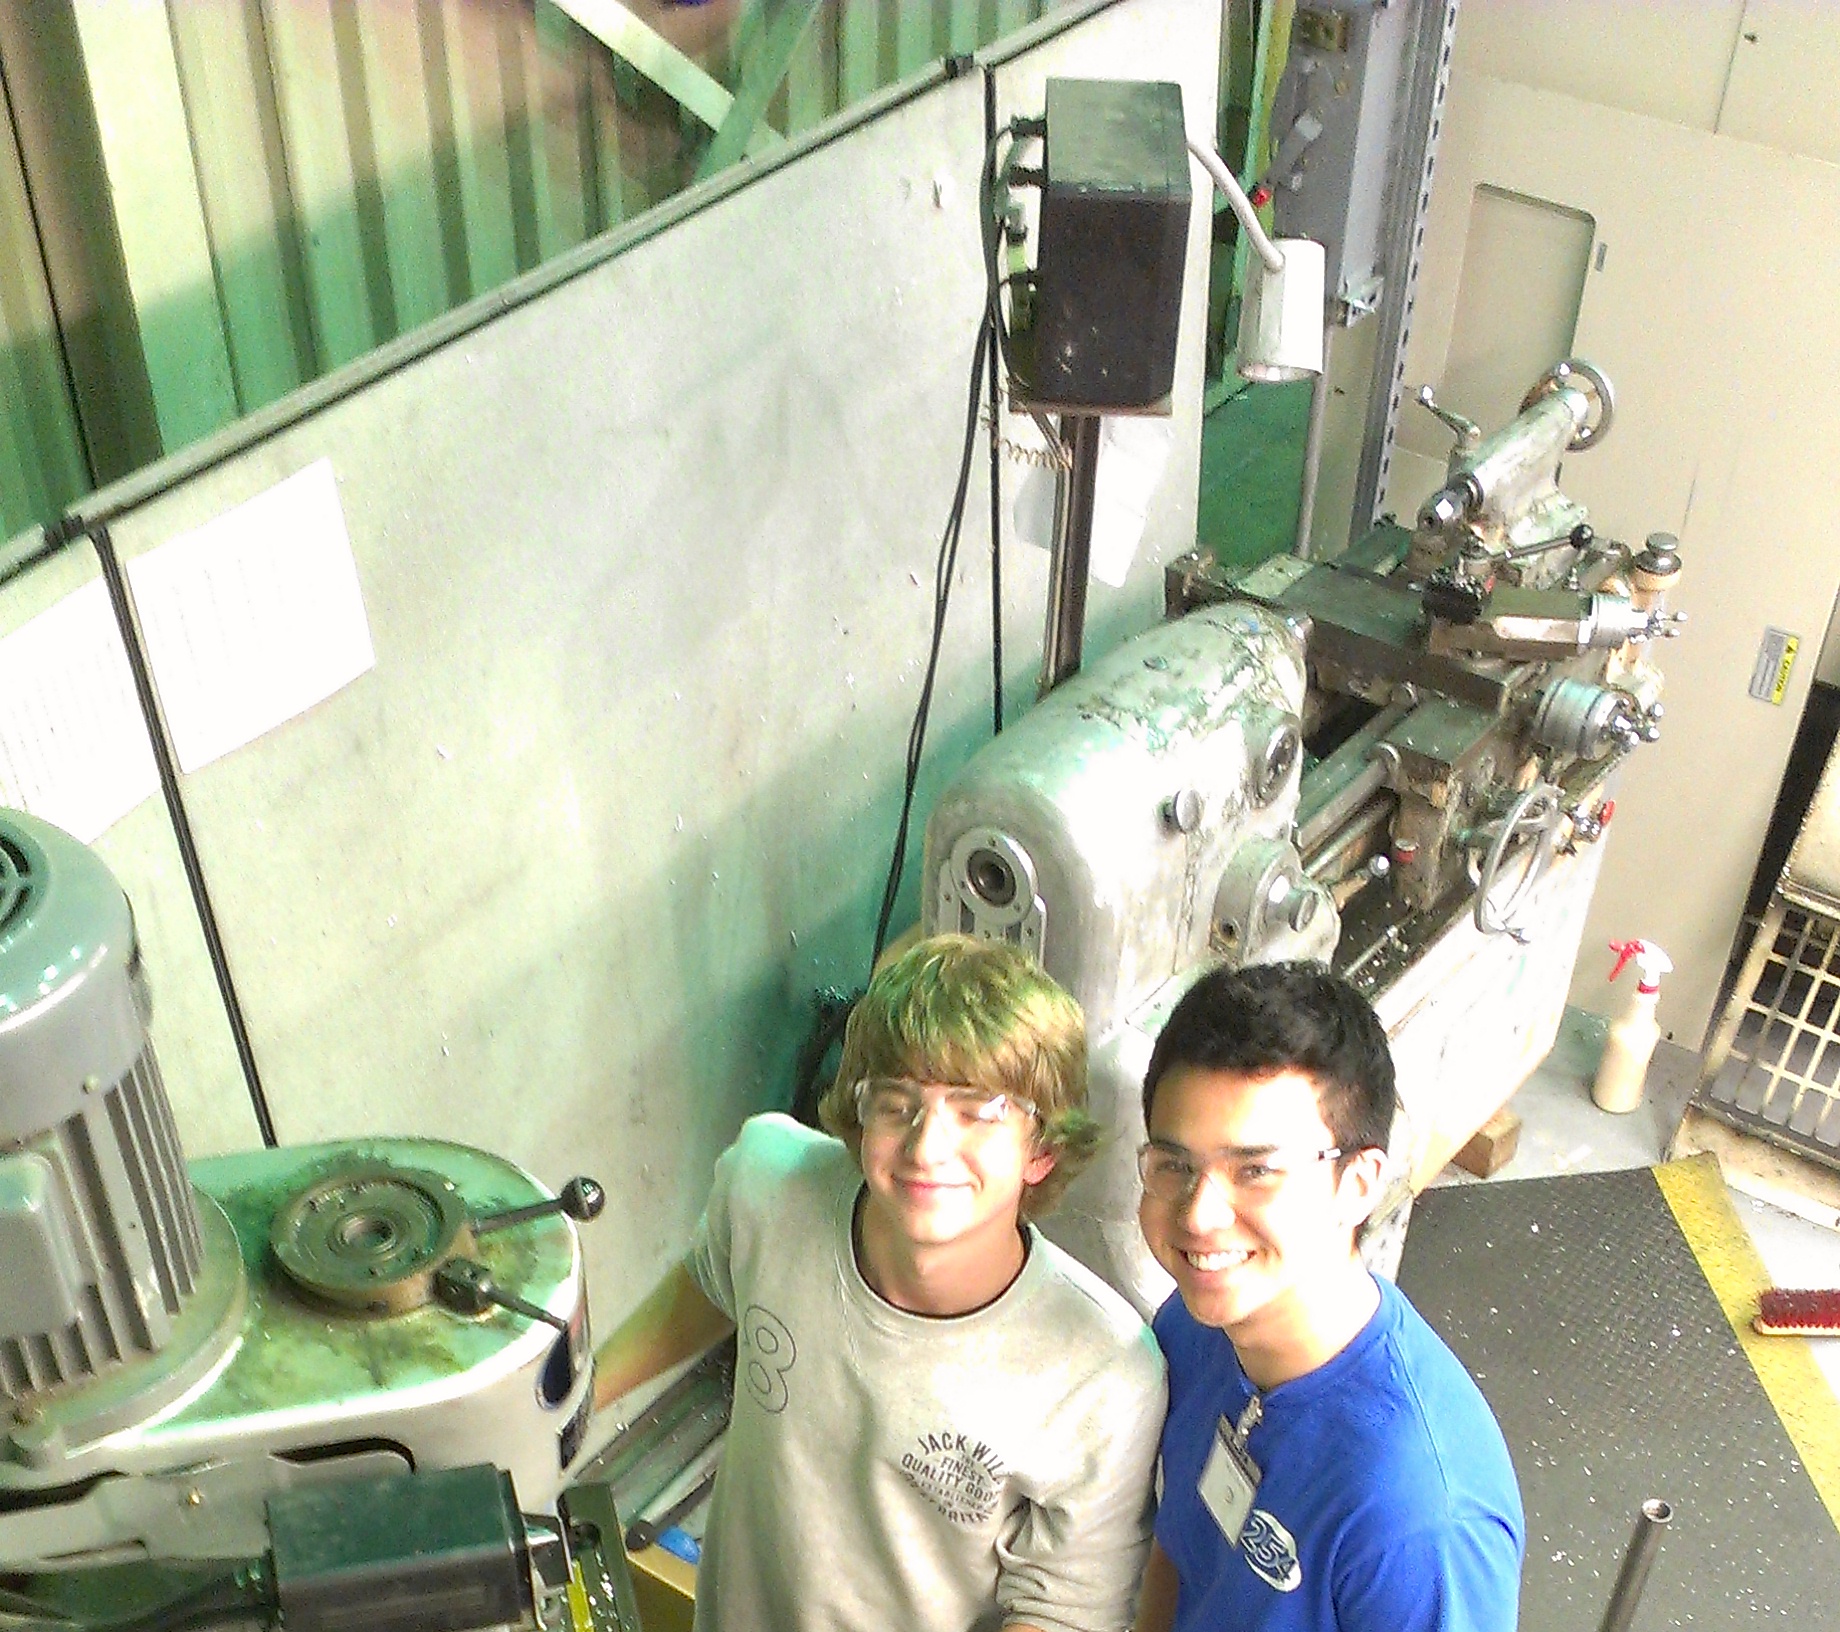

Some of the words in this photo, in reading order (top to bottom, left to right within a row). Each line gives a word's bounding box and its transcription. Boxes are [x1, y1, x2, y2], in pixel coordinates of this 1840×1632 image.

[743, 1303, 797, 1414] 8
[917, 1432, 967, 1456] JACK
[901, 1452, 963, 1489] QUALITY
[940, 1456, 984, 1486] FINEST
